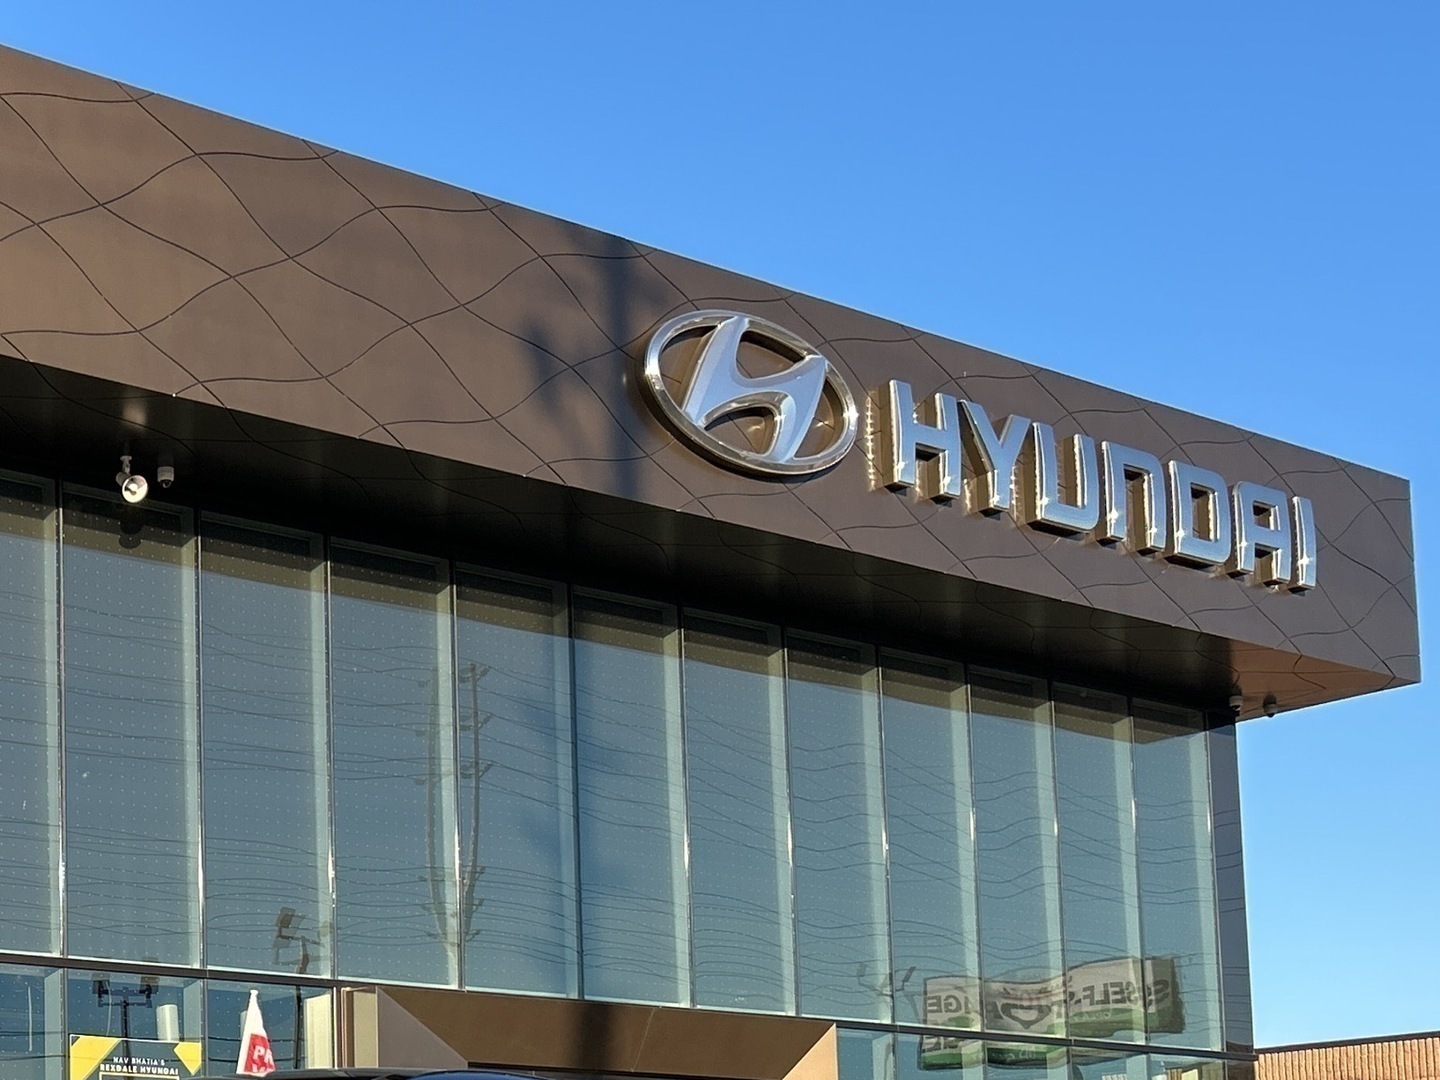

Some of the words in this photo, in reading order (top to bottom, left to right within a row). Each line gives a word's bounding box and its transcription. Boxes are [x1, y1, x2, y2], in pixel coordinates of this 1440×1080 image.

[885, 379, 1317, 591] HYUNDAI
[100, 1063, 138, 1073] REXDALE
[140, 1066, 179, 1076] HYUNDAI
